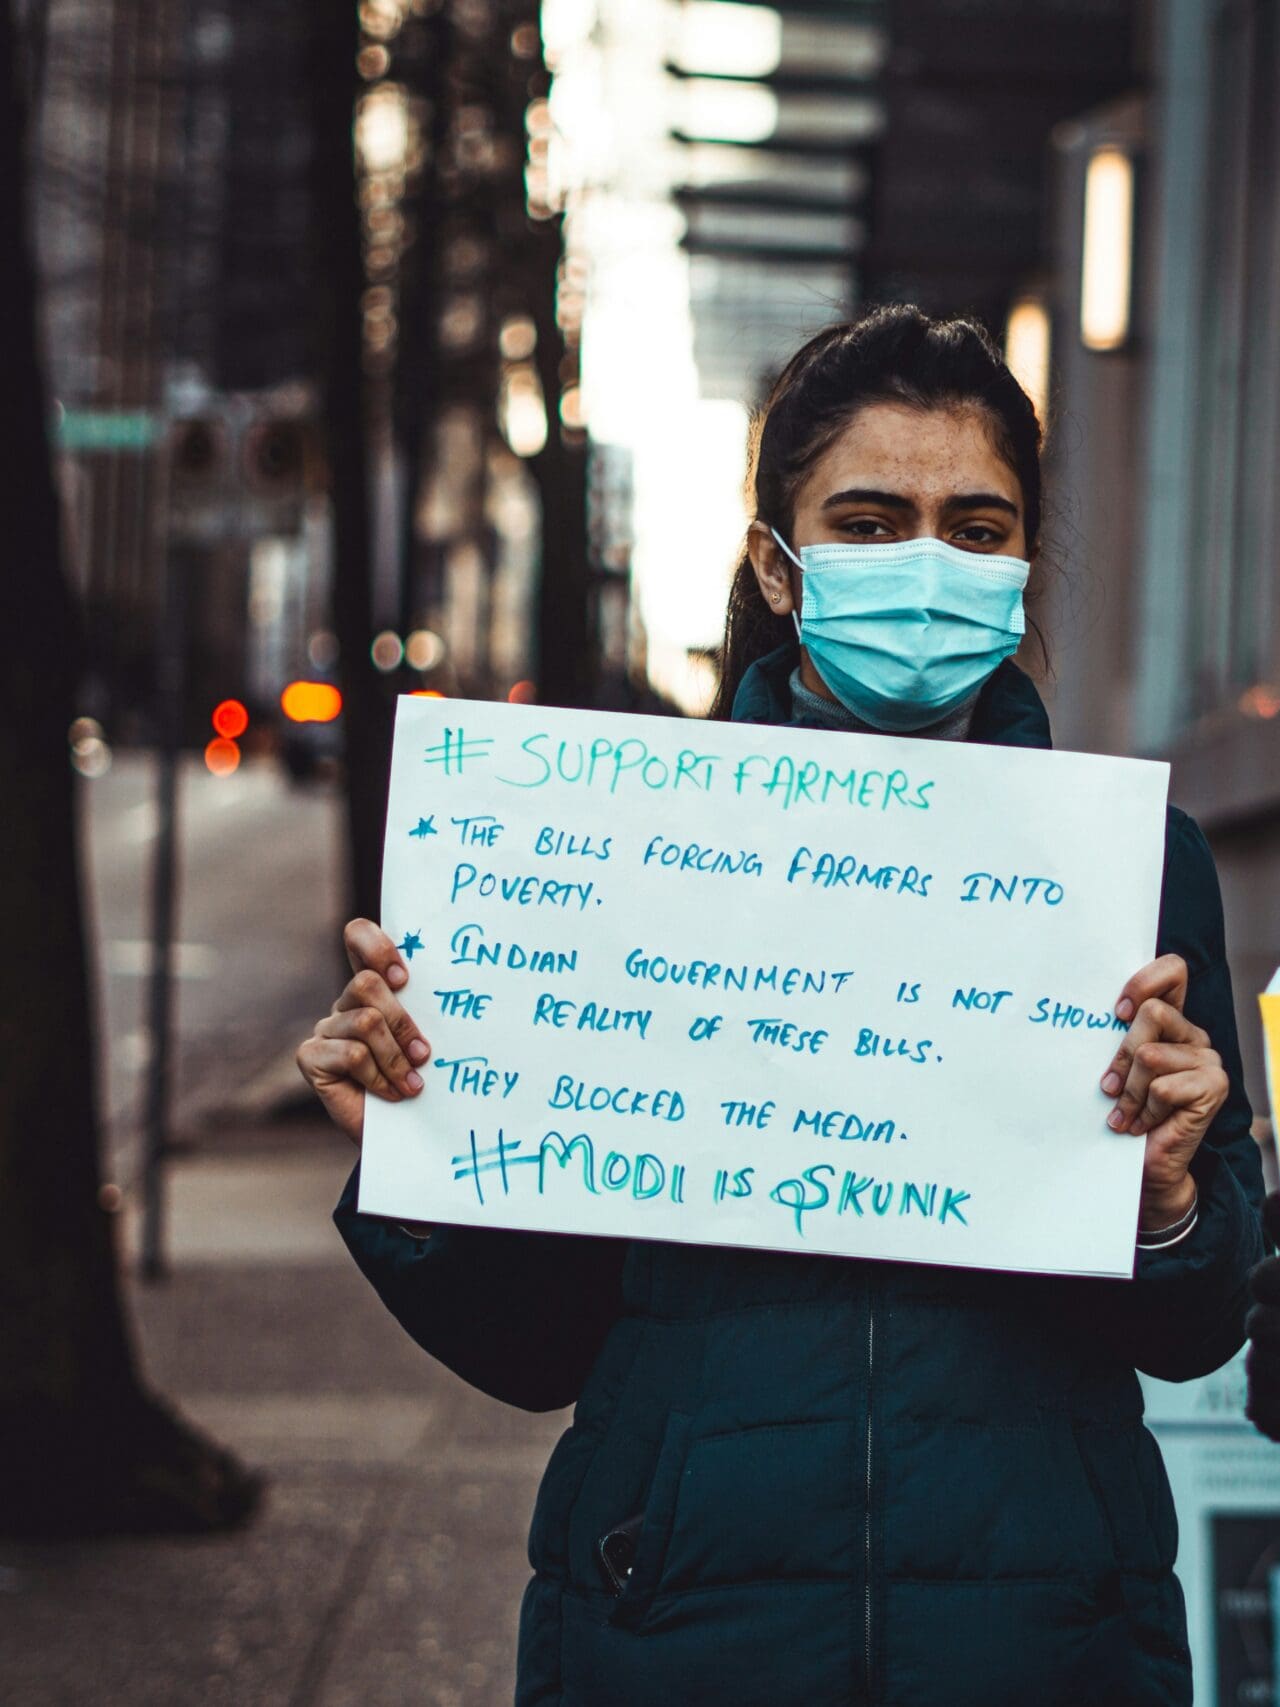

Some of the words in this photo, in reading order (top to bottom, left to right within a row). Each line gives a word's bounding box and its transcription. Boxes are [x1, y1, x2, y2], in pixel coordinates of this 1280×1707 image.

[450, 815, 505, 848] THE
[533, 826, 613, 861] BILLS
[643, 835, 764, 877] FORCING
[786, 846, 933, 898] FARMERS
[959, 871, 1065, 907] INTO
[450, 862, 604, 912] POVERTY.
[450, 923, 578, 974] INDIAN
[624, 947, 855, 994] GOVERNMENT
[896, 981, 922, 1004] IS
[951, 986, 1014, 1015] NOT
[432, 988, 493, 1021] THE
[532, 992, 653, 1040] REALITY
[687, 1014, 724, 1042] OF
[746, 1018, 830, 1055] THESE
[853, 1027, 943, 1064] BILLS.
[432, 1055, 520, 1099] THEY
[547, 1073, 686, 1123] BLOCKED
[720, 1100, 777, 1130] THE
[712, 1166, 756, 1204] IS
